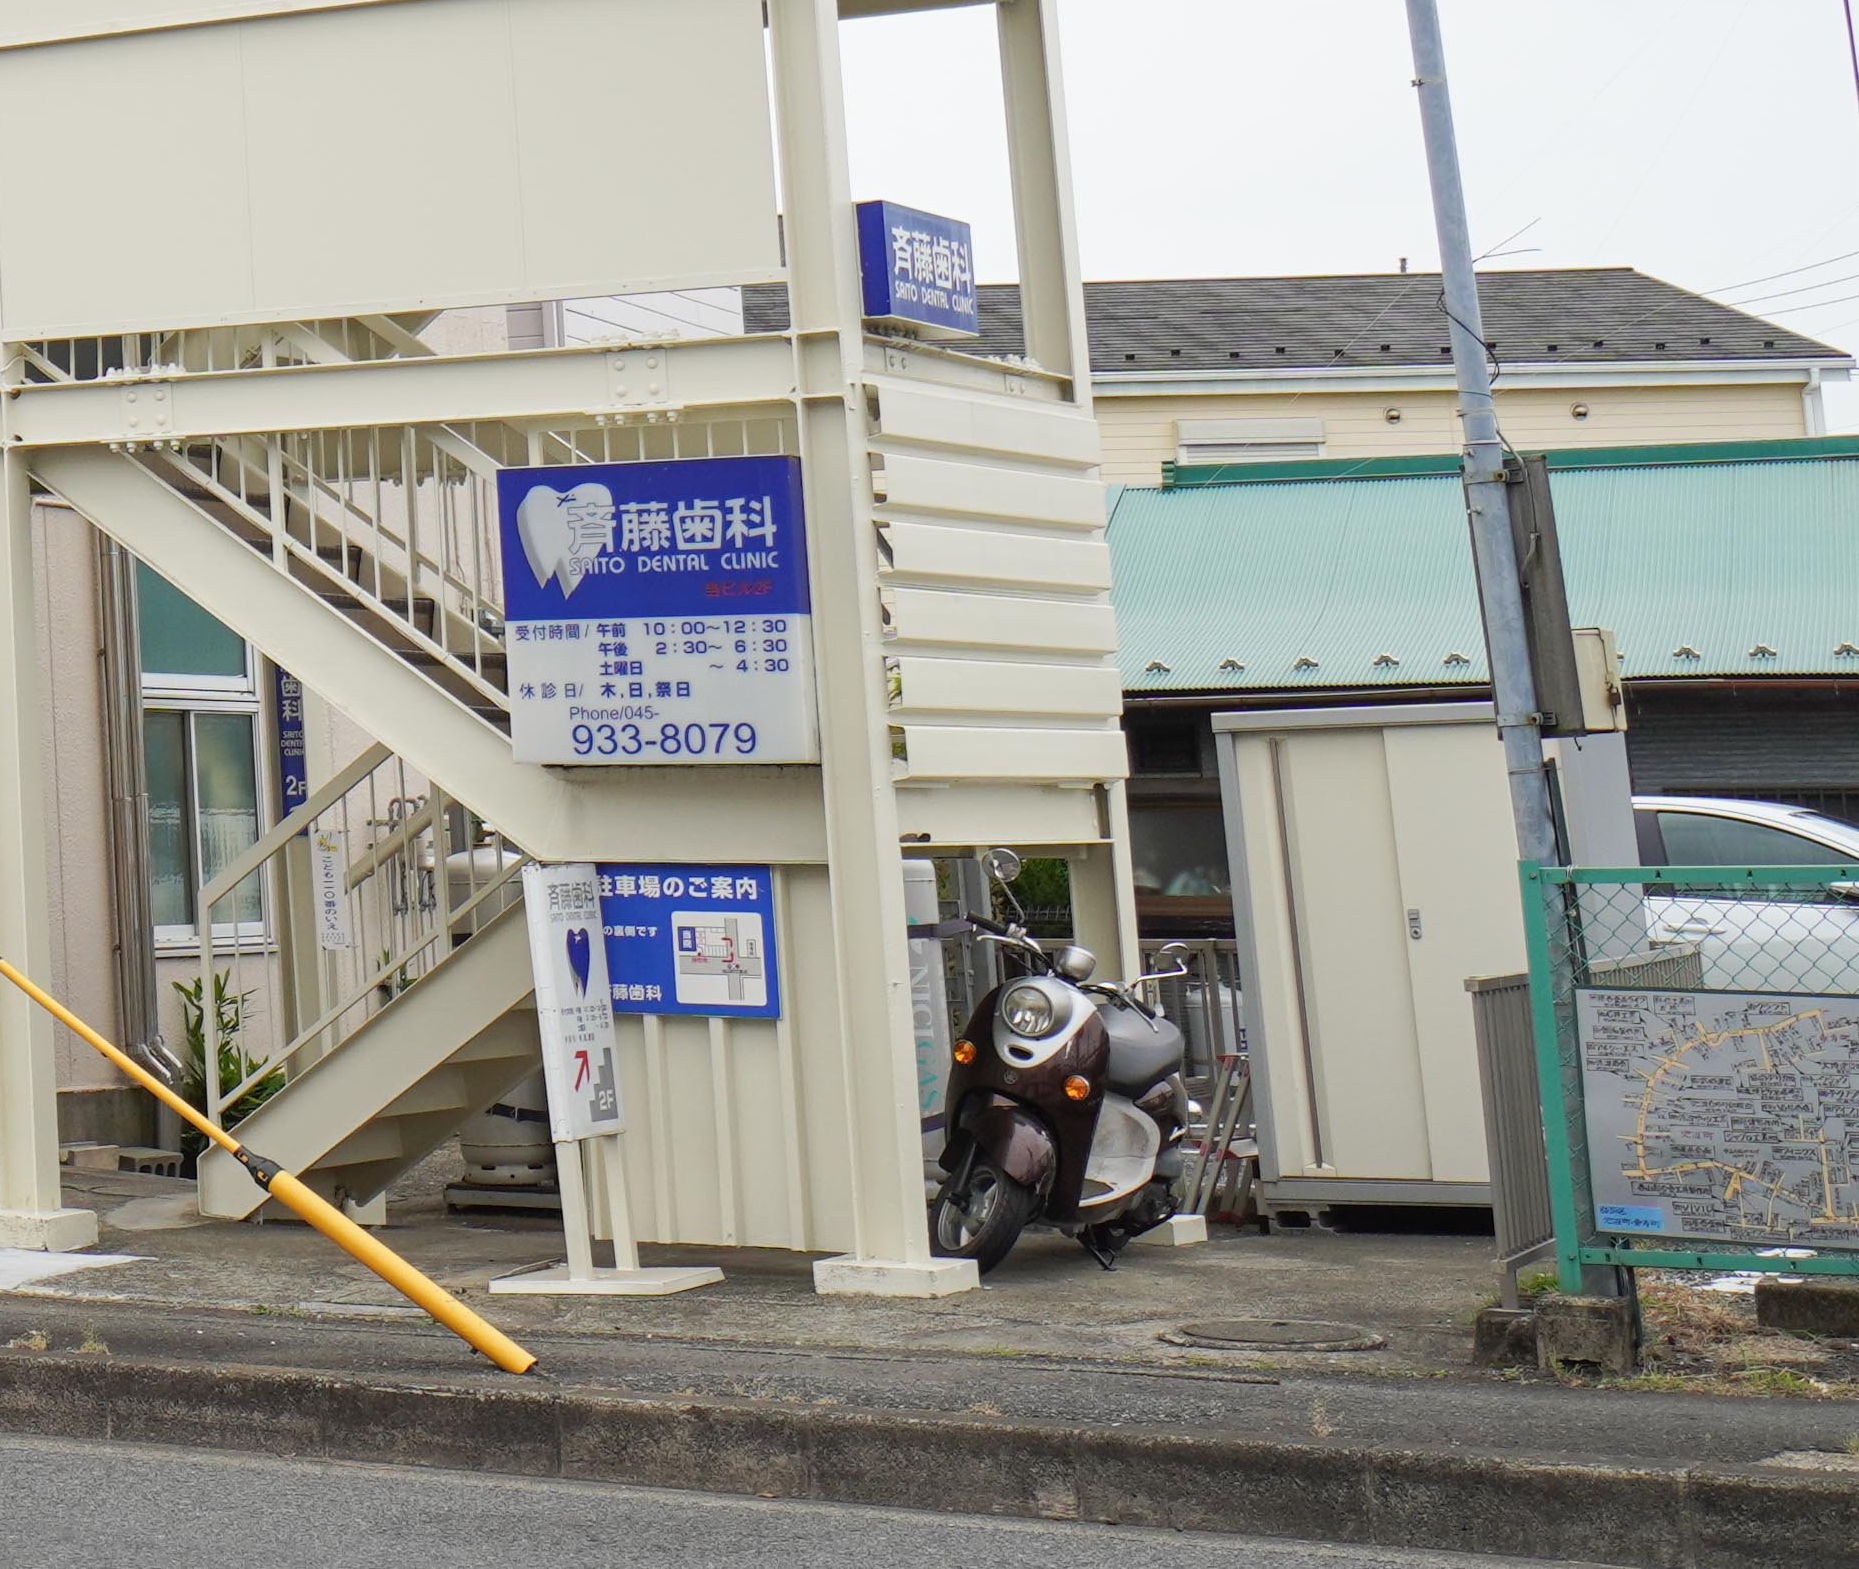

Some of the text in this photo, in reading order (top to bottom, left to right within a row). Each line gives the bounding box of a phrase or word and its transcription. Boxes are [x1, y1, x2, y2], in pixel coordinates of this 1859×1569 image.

[891, 226, 972, 293] 斉藤歯科
[895, 280, 974, 315] SAITO DENTAL CLINIC
[568, 495, 777, 554] 斉藤歯科
[569, 550, 779, 576] SAITO DENTAL CLINIC
[596, 622, 627, 638] 午前
[598, 641, 628, 658] 午後
[599, 660, 643, 677] 土曜日
[571, 722, 757, 755] 933-8079
[609, 984, 663, 1001] 藤歯科
[599, 1090, 615, 1110] 2F
